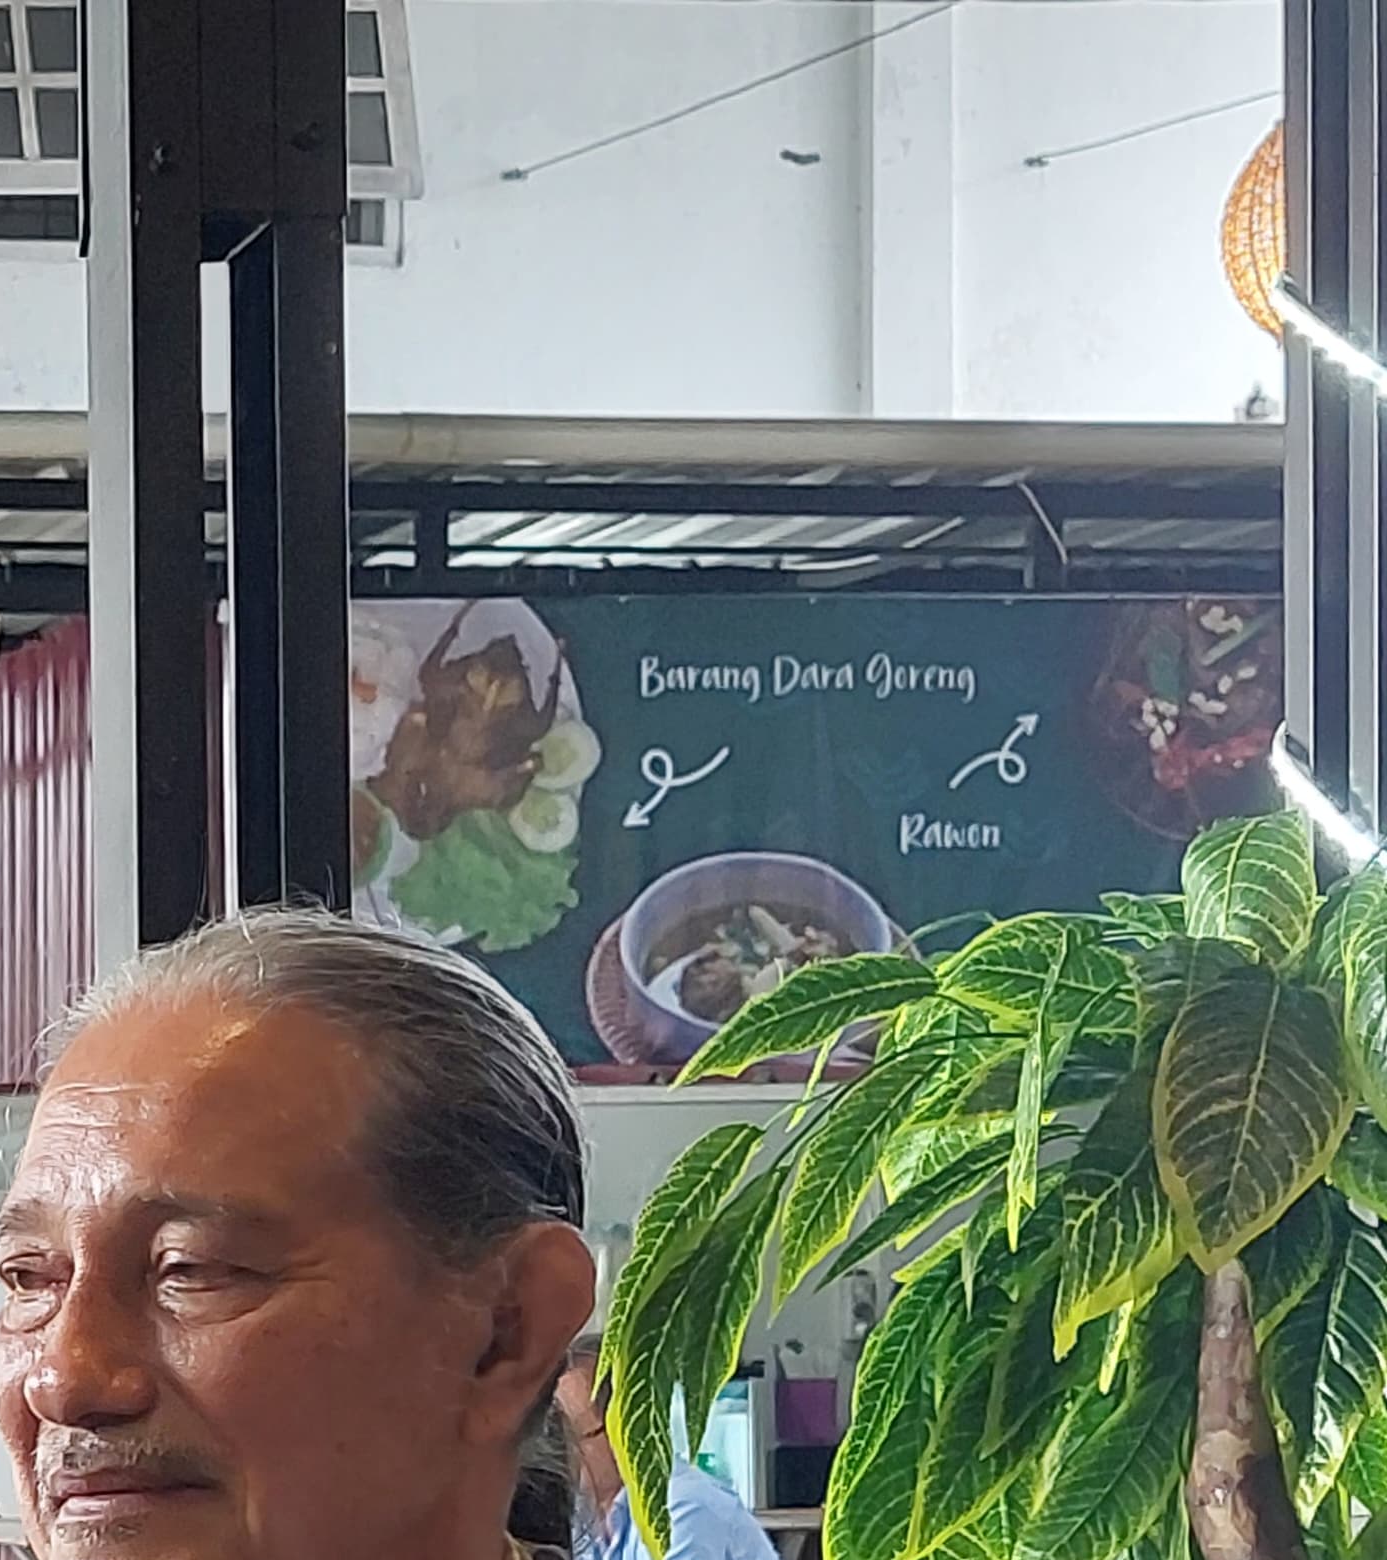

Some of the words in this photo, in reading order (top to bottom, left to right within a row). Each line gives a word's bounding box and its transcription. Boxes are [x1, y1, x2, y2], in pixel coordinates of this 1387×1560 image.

[640, 654, 762, 703] Barang
[773, 654, 854, 696] Dara
[866, 652, 976, 703] Goreng
[900, 812, 1000, 855] Rawon
